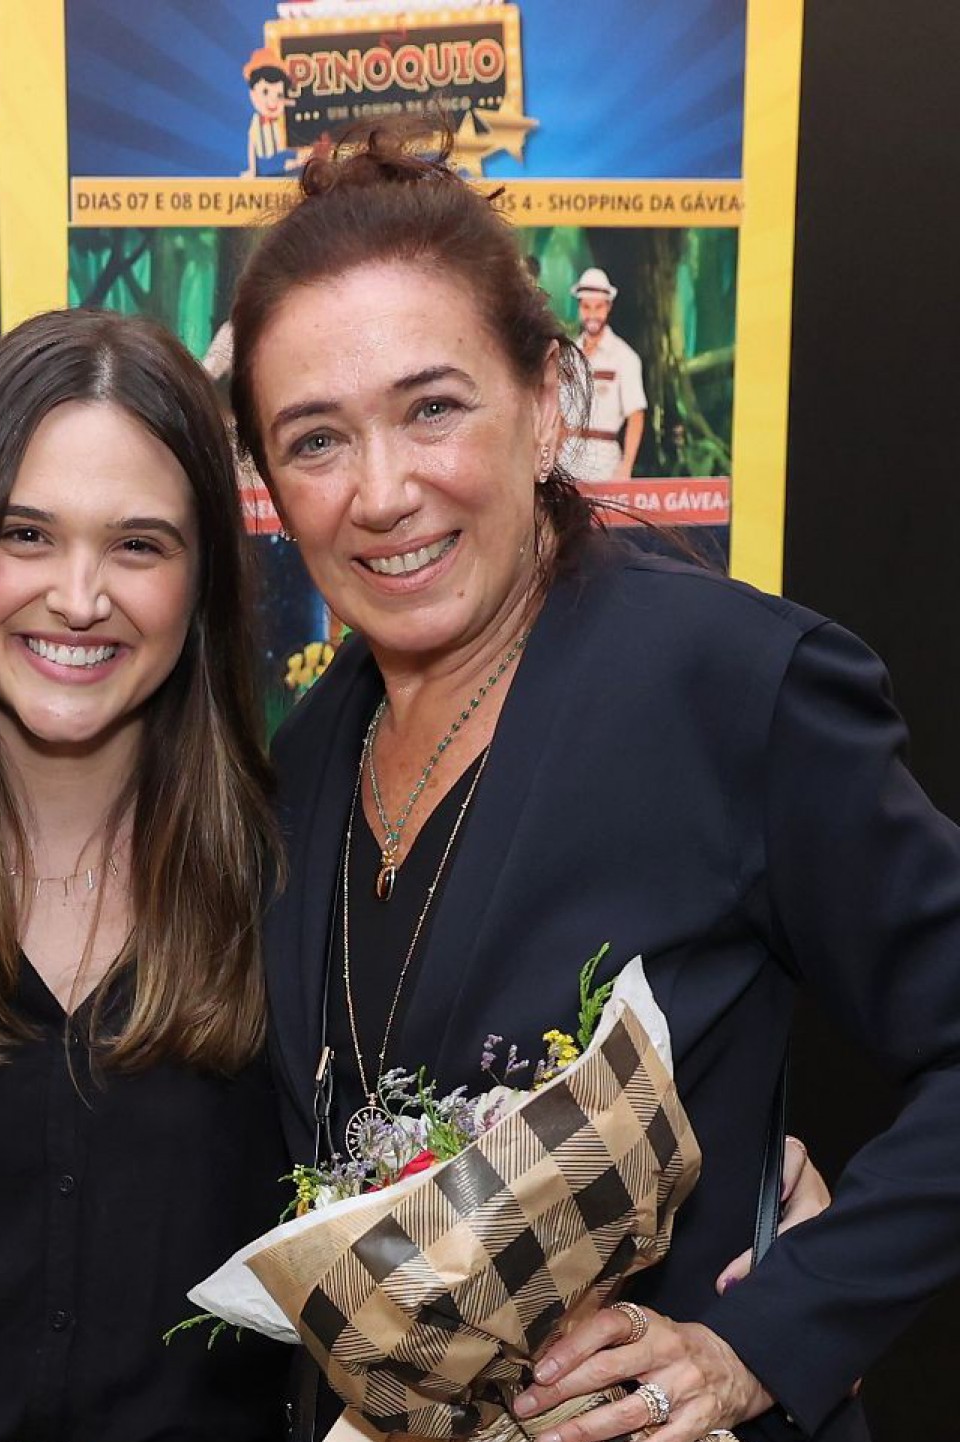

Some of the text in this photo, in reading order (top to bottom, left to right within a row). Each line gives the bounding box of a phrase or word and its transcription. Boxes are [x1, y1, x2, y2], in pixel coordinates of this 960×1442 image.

[286, 39, 505, 97] PINOQUIO
[76, 192, 122, 211] DIAS
[126, 192, 149, 211] 07
[155, 192, 164, 211] E
[170, 192, 193, 211] 08
[198, 192, 222, 211] DE
[522, 193, 532, 211] 4
[548, 193, 644, 212] SHOPPING
[650, 193, 675, 211] DA
[680, 190, 741, 212] GÁVEA
[633, 493, 660, 511] DA
[663, 487, 725, 511] GÁVEA
